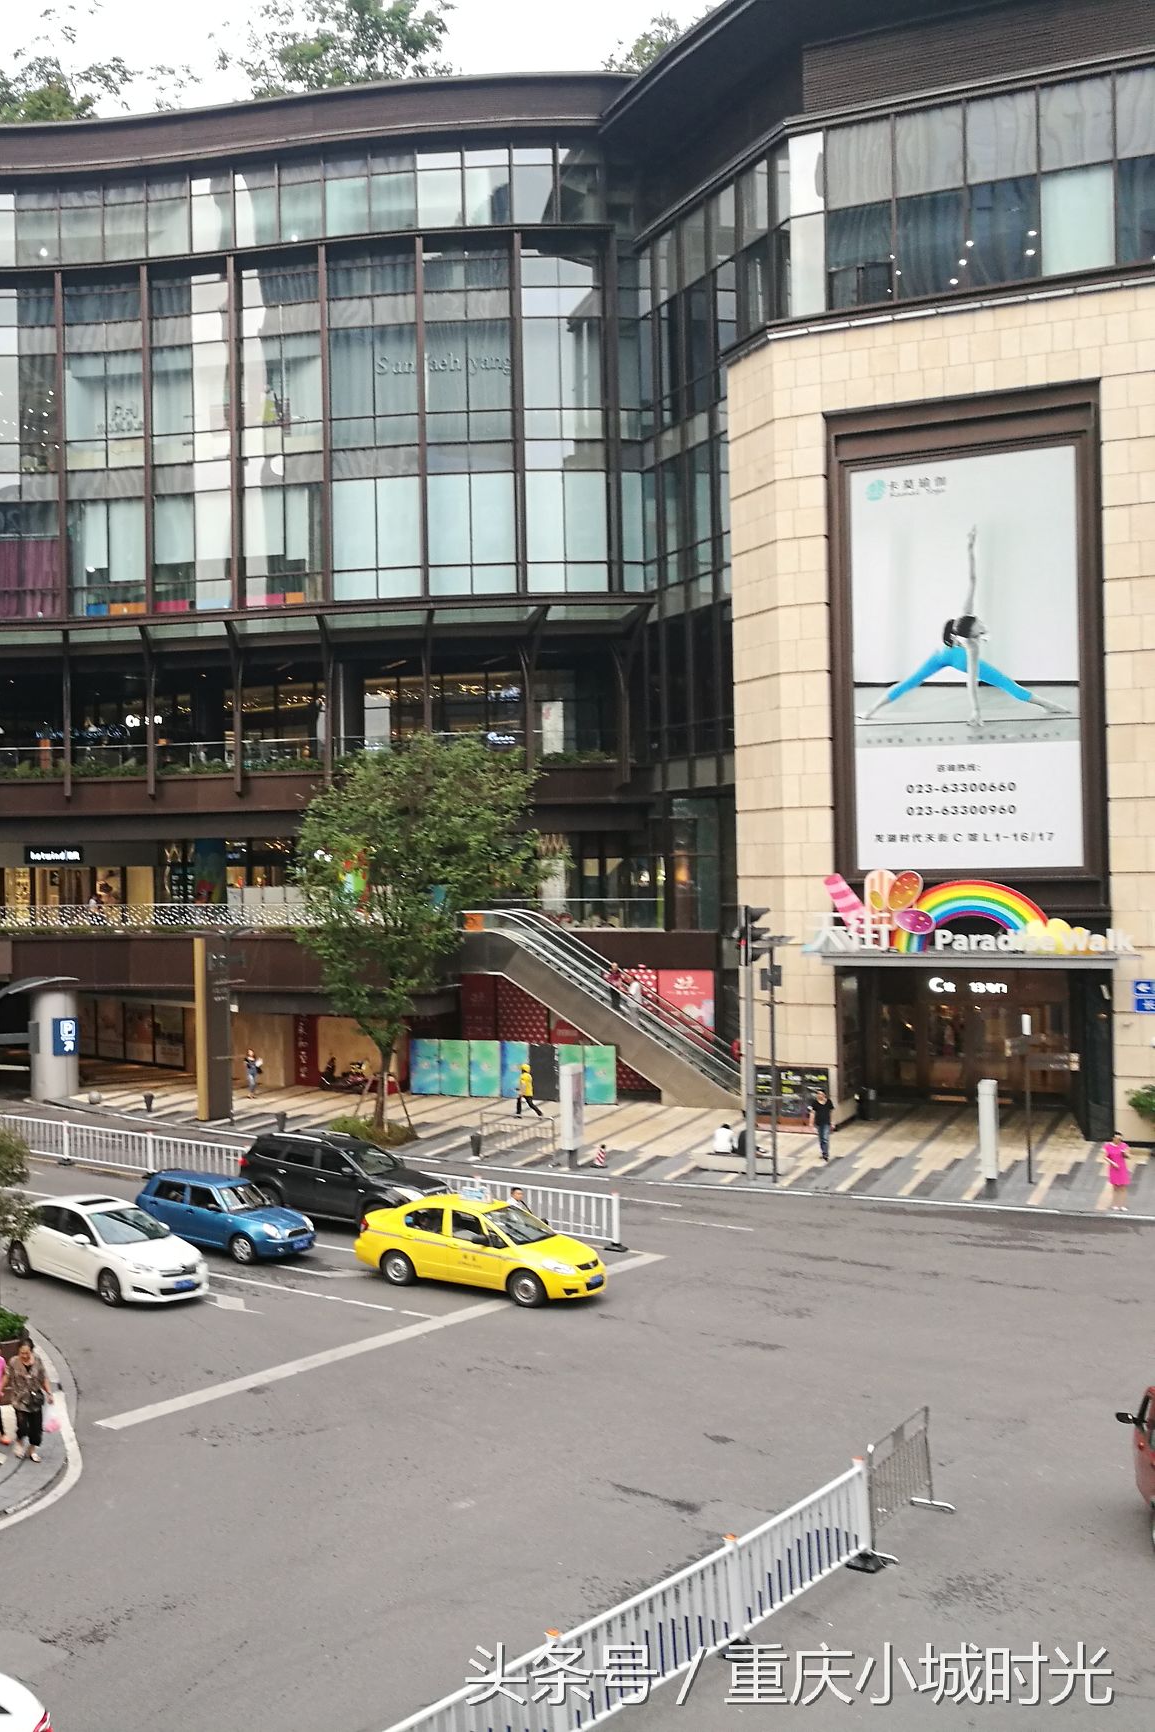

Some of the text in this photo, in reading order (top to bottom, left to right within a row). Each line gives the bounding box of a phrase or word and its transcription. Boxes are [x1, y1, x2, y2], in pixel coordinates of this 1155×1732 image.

[906, 781, 1017, 794] 023-63300660
[906, 803, 1017, 816] 023-63300960
[802, 911, 892, 952] 天街
[1059, 928, 1135, 952] Walk
